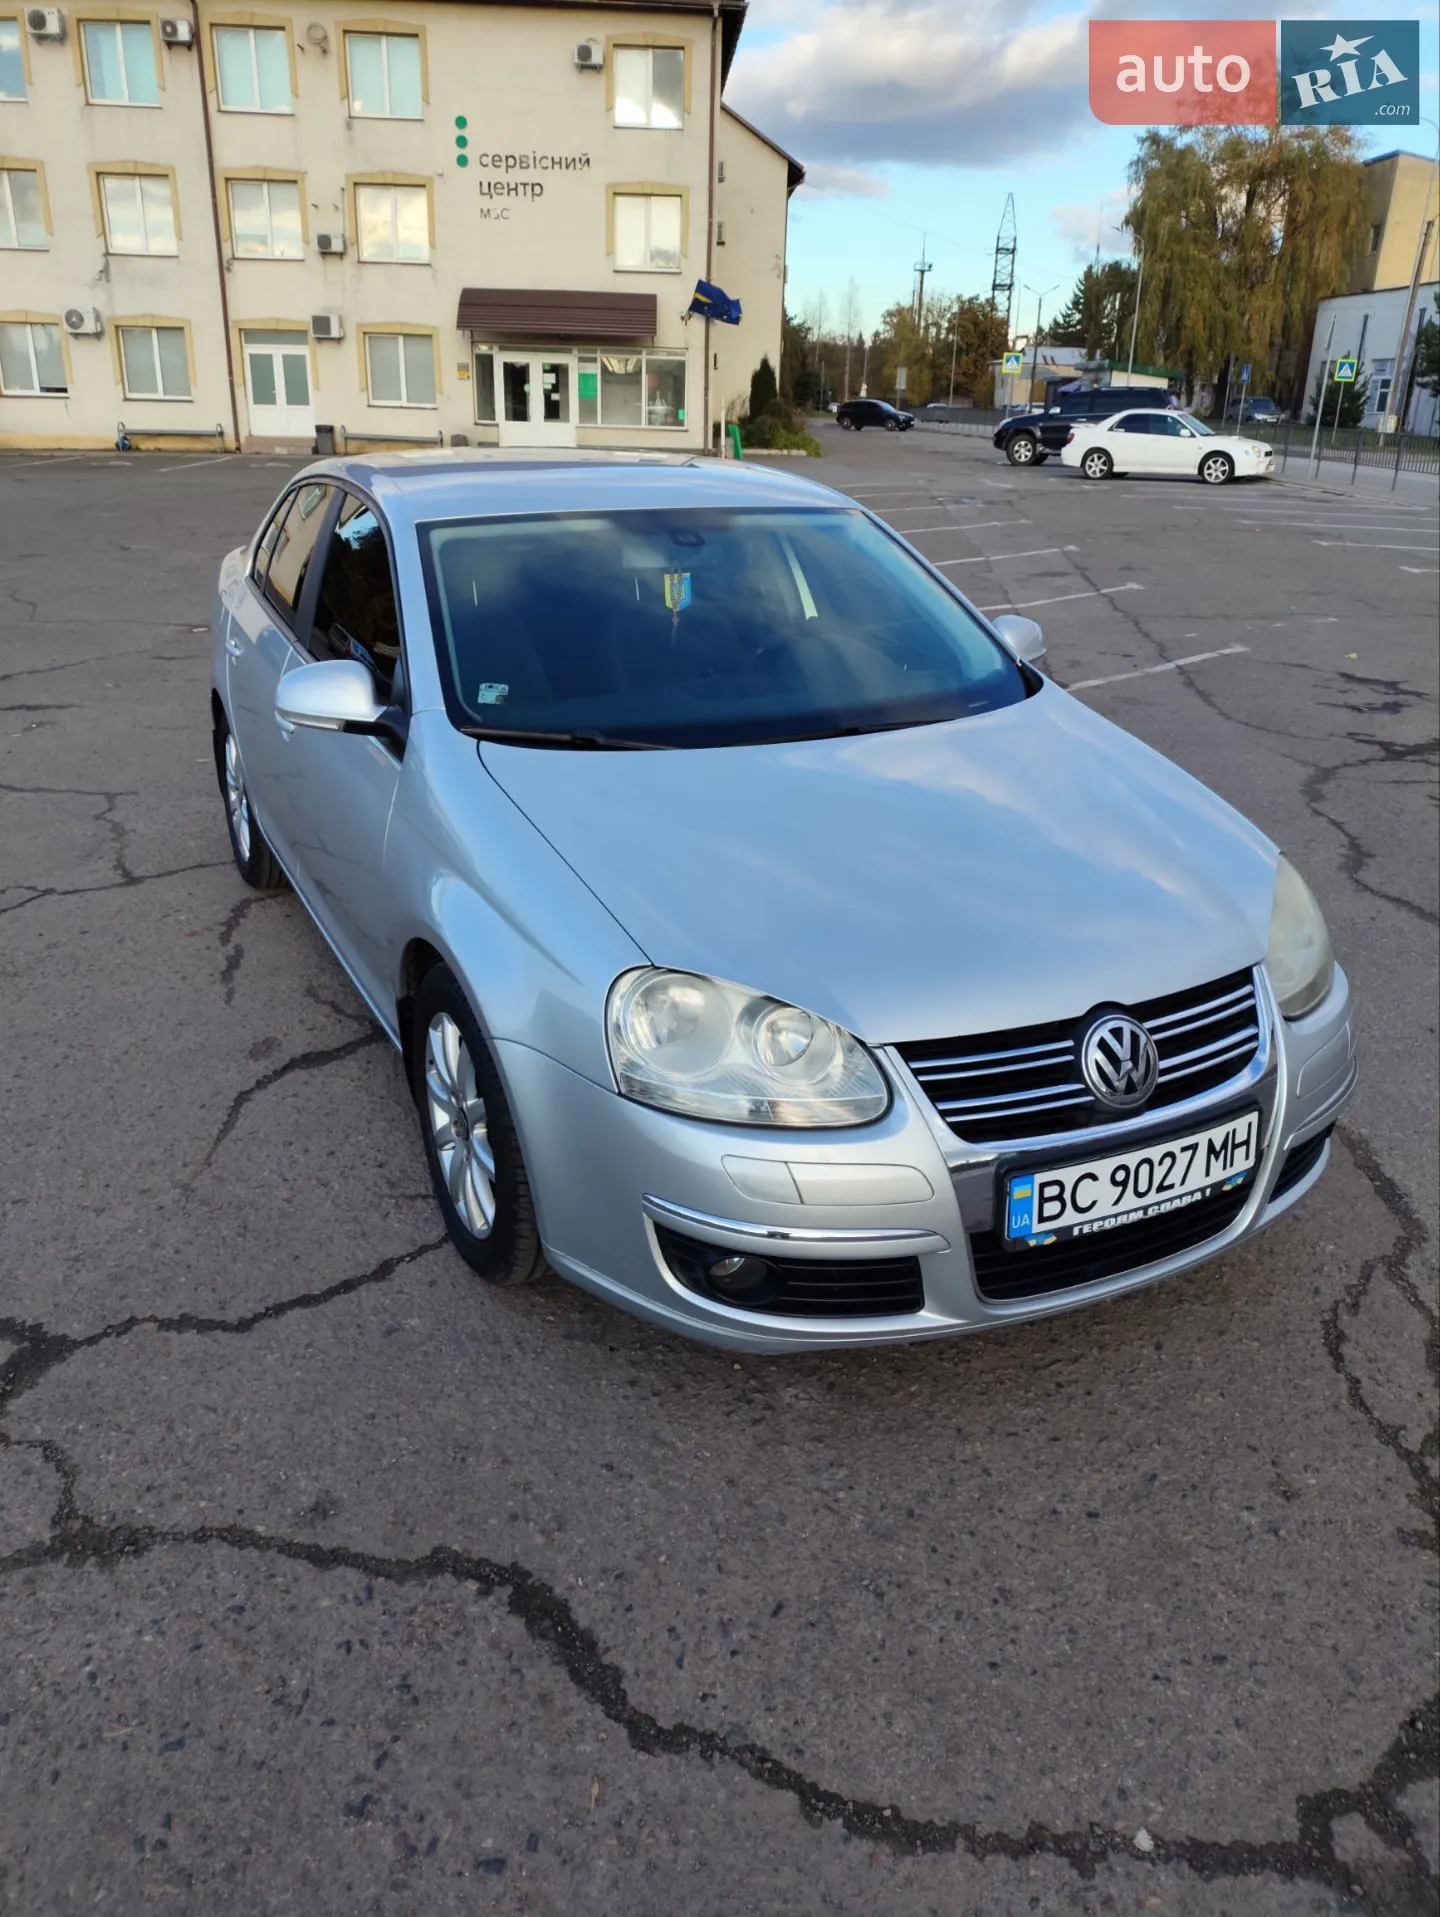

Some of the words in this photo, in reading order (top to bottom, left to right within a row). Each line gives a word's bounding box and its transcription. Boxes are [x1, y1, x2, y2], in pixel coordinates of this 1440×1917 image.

[479, 150, 591, 174] сервісний
[479, 181, 544, 202] центр
[1037, 1172, 1100, 1225] BC
[1109, 1142, 1200, 1207] 9027
[1204, 1121, 1253, 1178] MH
[1012, 1213, 1031, 1229] UA
[1072, 1209, 1144, 1236] ГЕРОЯМ
